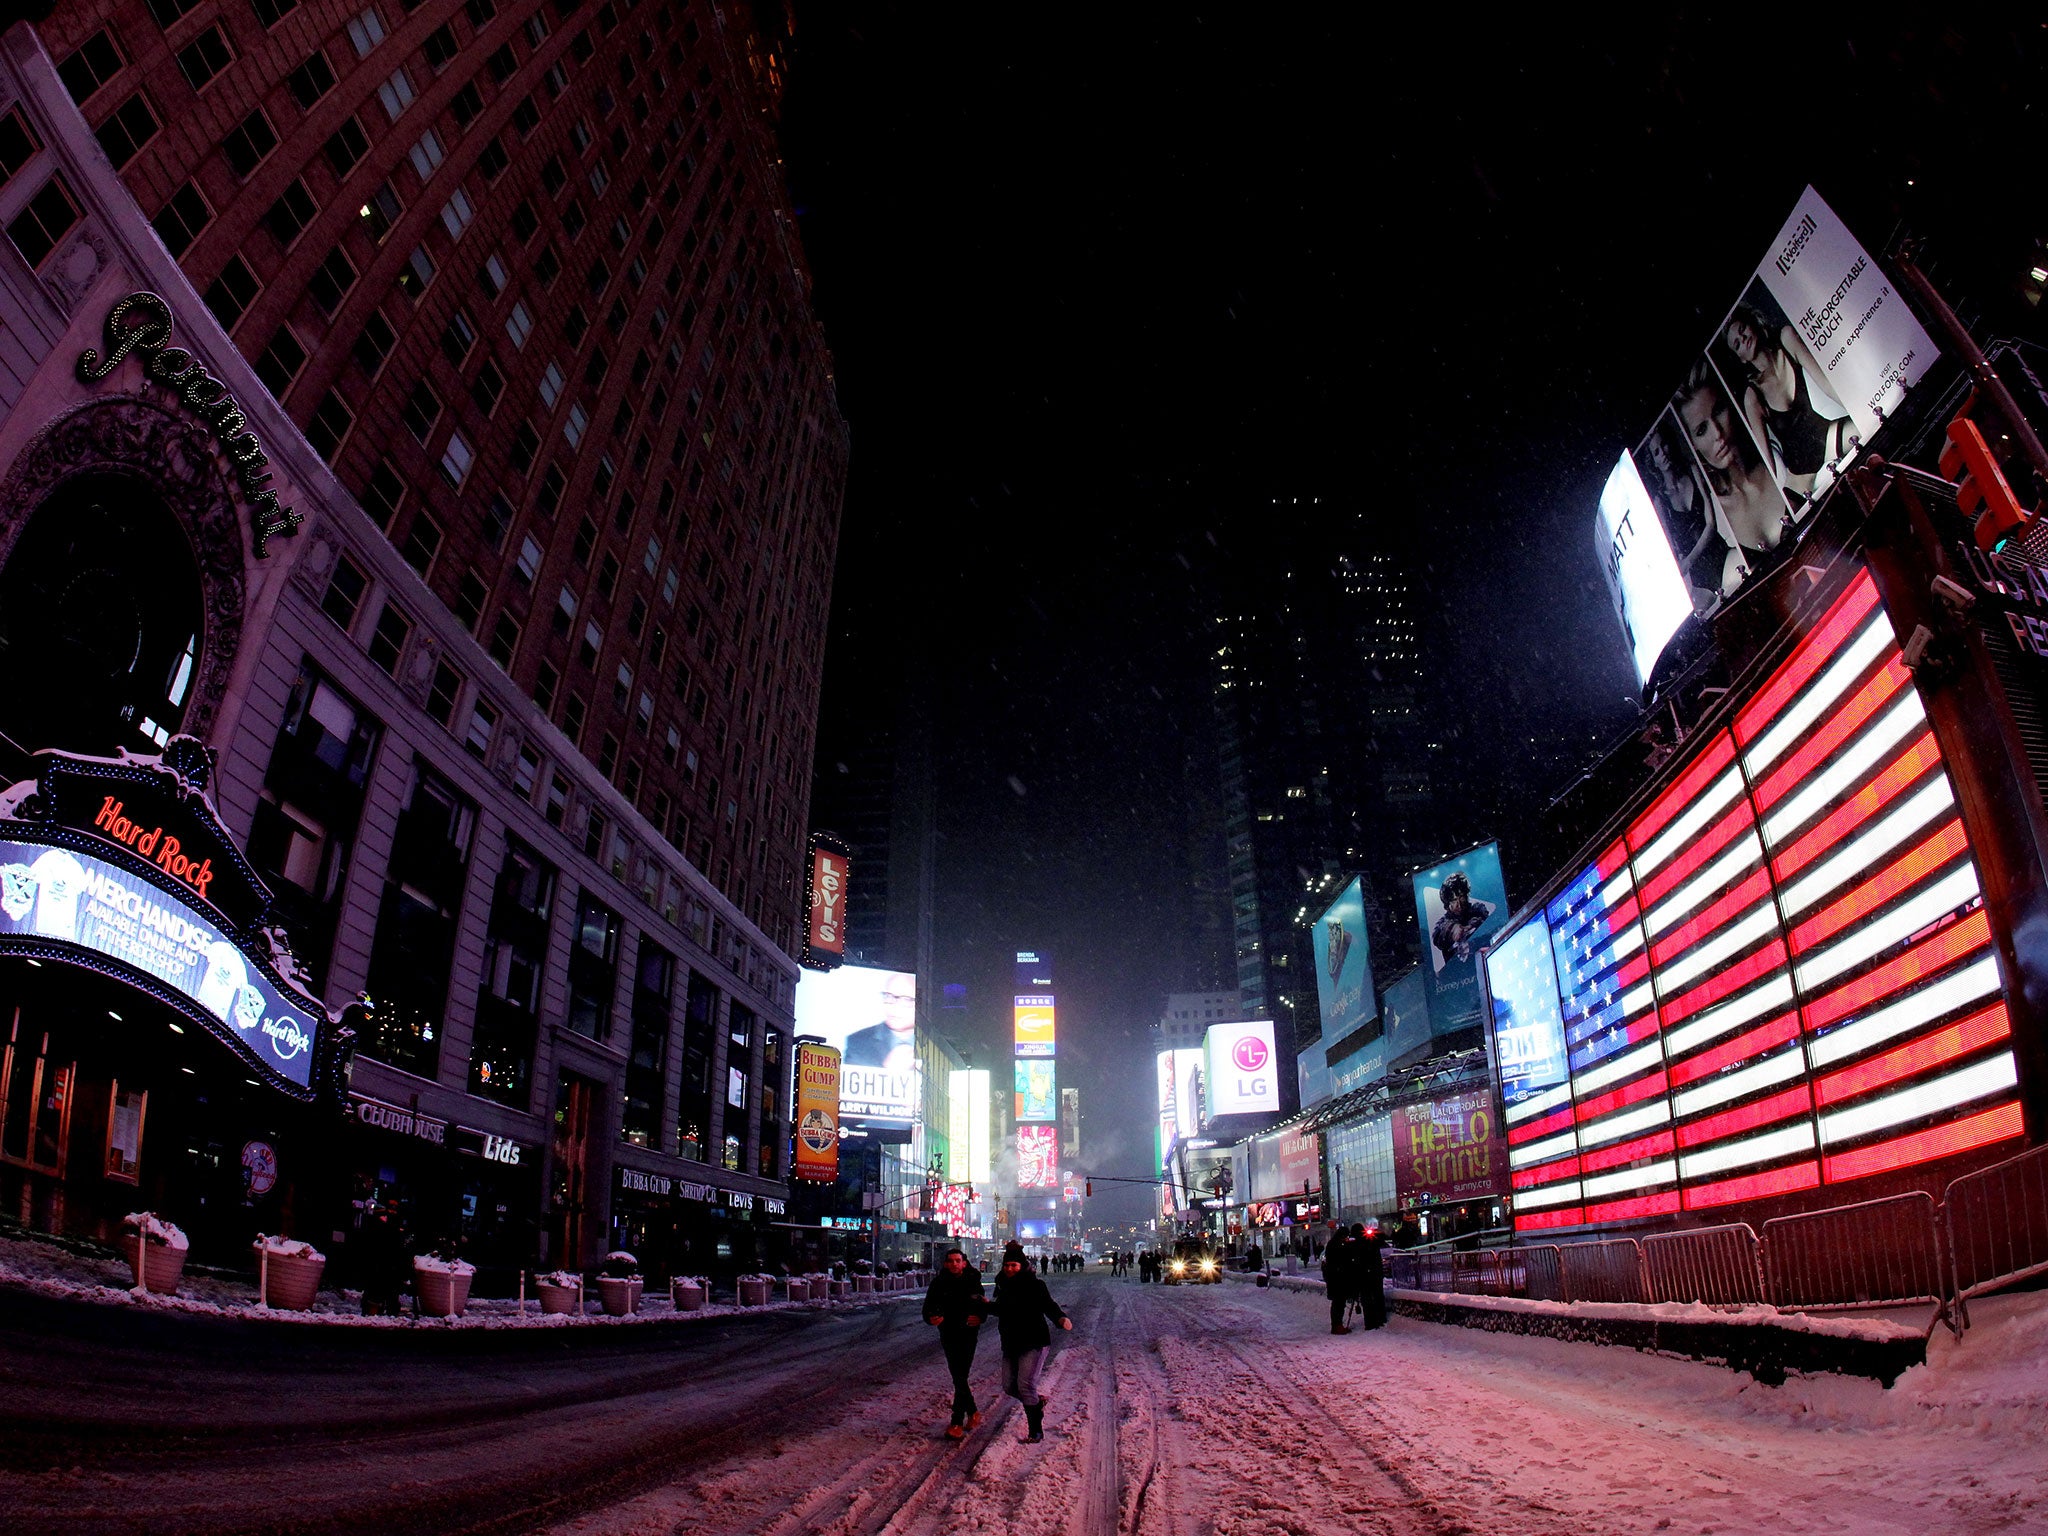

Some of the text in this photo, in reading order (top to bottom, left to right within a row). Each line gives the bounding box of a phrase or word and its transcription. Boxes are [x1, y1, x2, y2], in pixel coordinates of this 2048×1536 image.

[1806, 255, 1868, 341] UNFORGETTABLE
[1799, 307, 1817, 330] THE
[1813, 312, 1843, 352] TOUCH
[1827, 286, 1890, 371] come experience it
[1868, 350, 1916, 410] WOLFORD.COM
[1879, 363, 1892, 379] VISIT
[75, 291, 305, 559] Paramount
[94, 796, 213, 897] Hard Rock
[84, 868, 212, 956] MERCHANDISE
[86, 900, 199, 967] AVAILABLE ONLINE AND
[157, 954, 185, 976] SHOP
[262, 1017, 310, 1053] Hard Rock
[802, 1050, 838, 1070] BUBBA
[804, 1068, 835, 1086] GUMP
[842, 1071, 910, 1099] IGHTLY
[1238, 1078, 1267, 1097] LG
[839, 1101, 868, 1114] ARRY
[1410, 1111, 1431, 1123] FORT
[1432, 1098, 1487, 1118] LAUDERDALE
[484, 1135, 521, 1165] Lids
[622, 1169, 649, 1192] BUBBA
[650, 1175, 671, 1195] GUMP
[680, 1180, 706, 1201] SHRIMP
